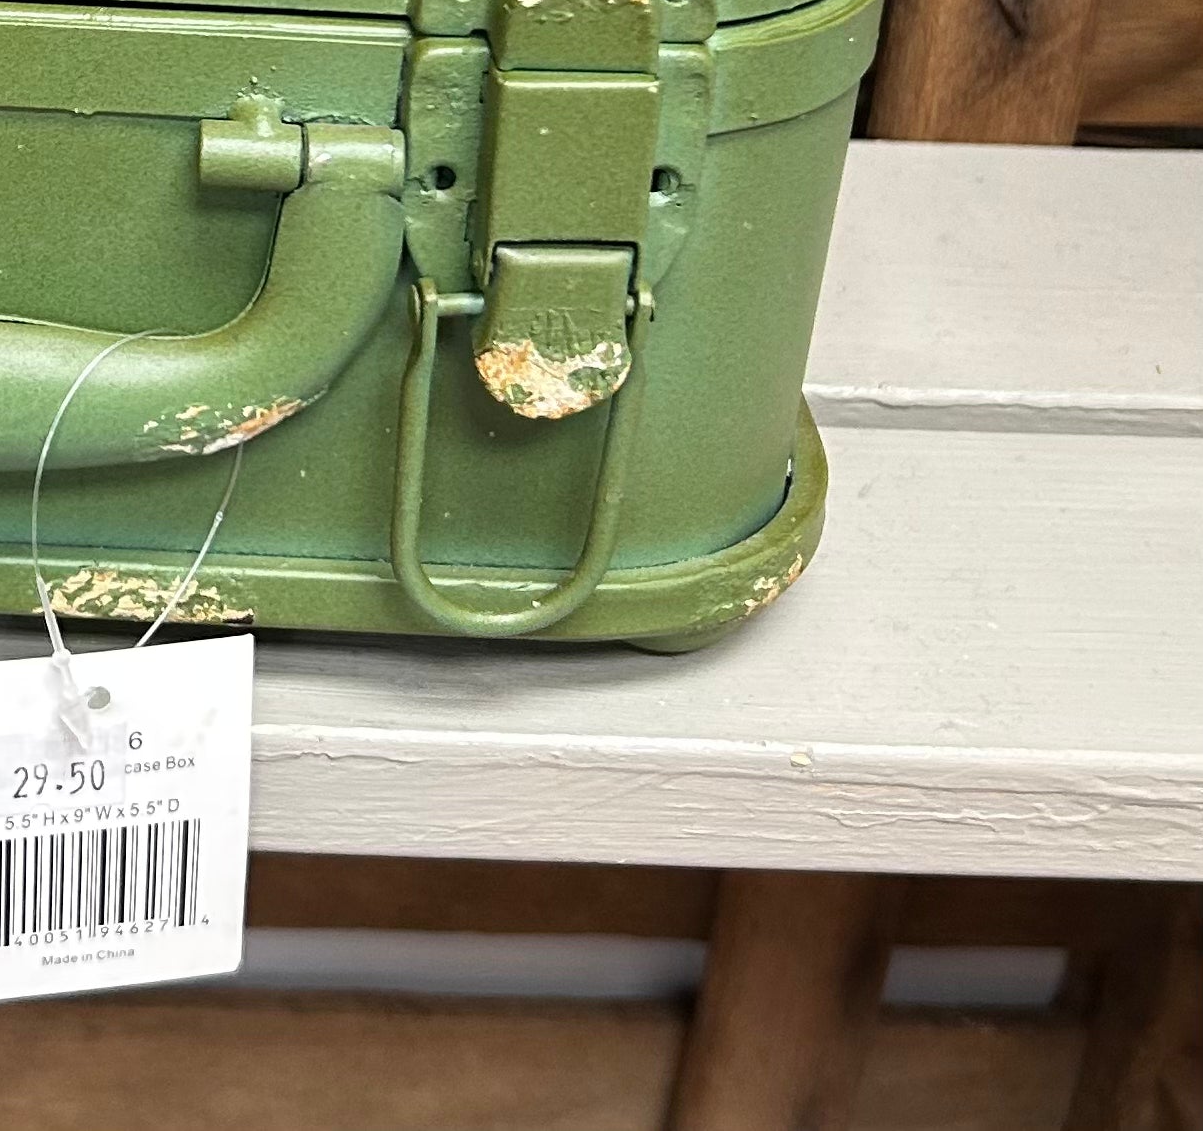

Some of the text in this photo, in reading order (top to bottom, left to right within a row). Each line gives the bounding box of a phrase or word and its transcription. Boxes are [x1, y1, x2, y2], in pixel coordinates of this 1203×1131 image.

[128, 731, 143, 750] 6
[166, 755, 195, 770] Box
[13, 759, 105, 799] 29.50
[43, 810, 55, 826] H
[60, 813, 70, 825] x
[74, 807, 91, 823] 9"
[95, 805, 112, 821] W
[116, 807, 125, 819] x
[168, 798, 180, 813] D
[14, 928, 82, 947] 40051
[100, 918, 169, 938] 94627
[201, 913, 210, 925] 4
[41, 948, 135, 966] Made in China
